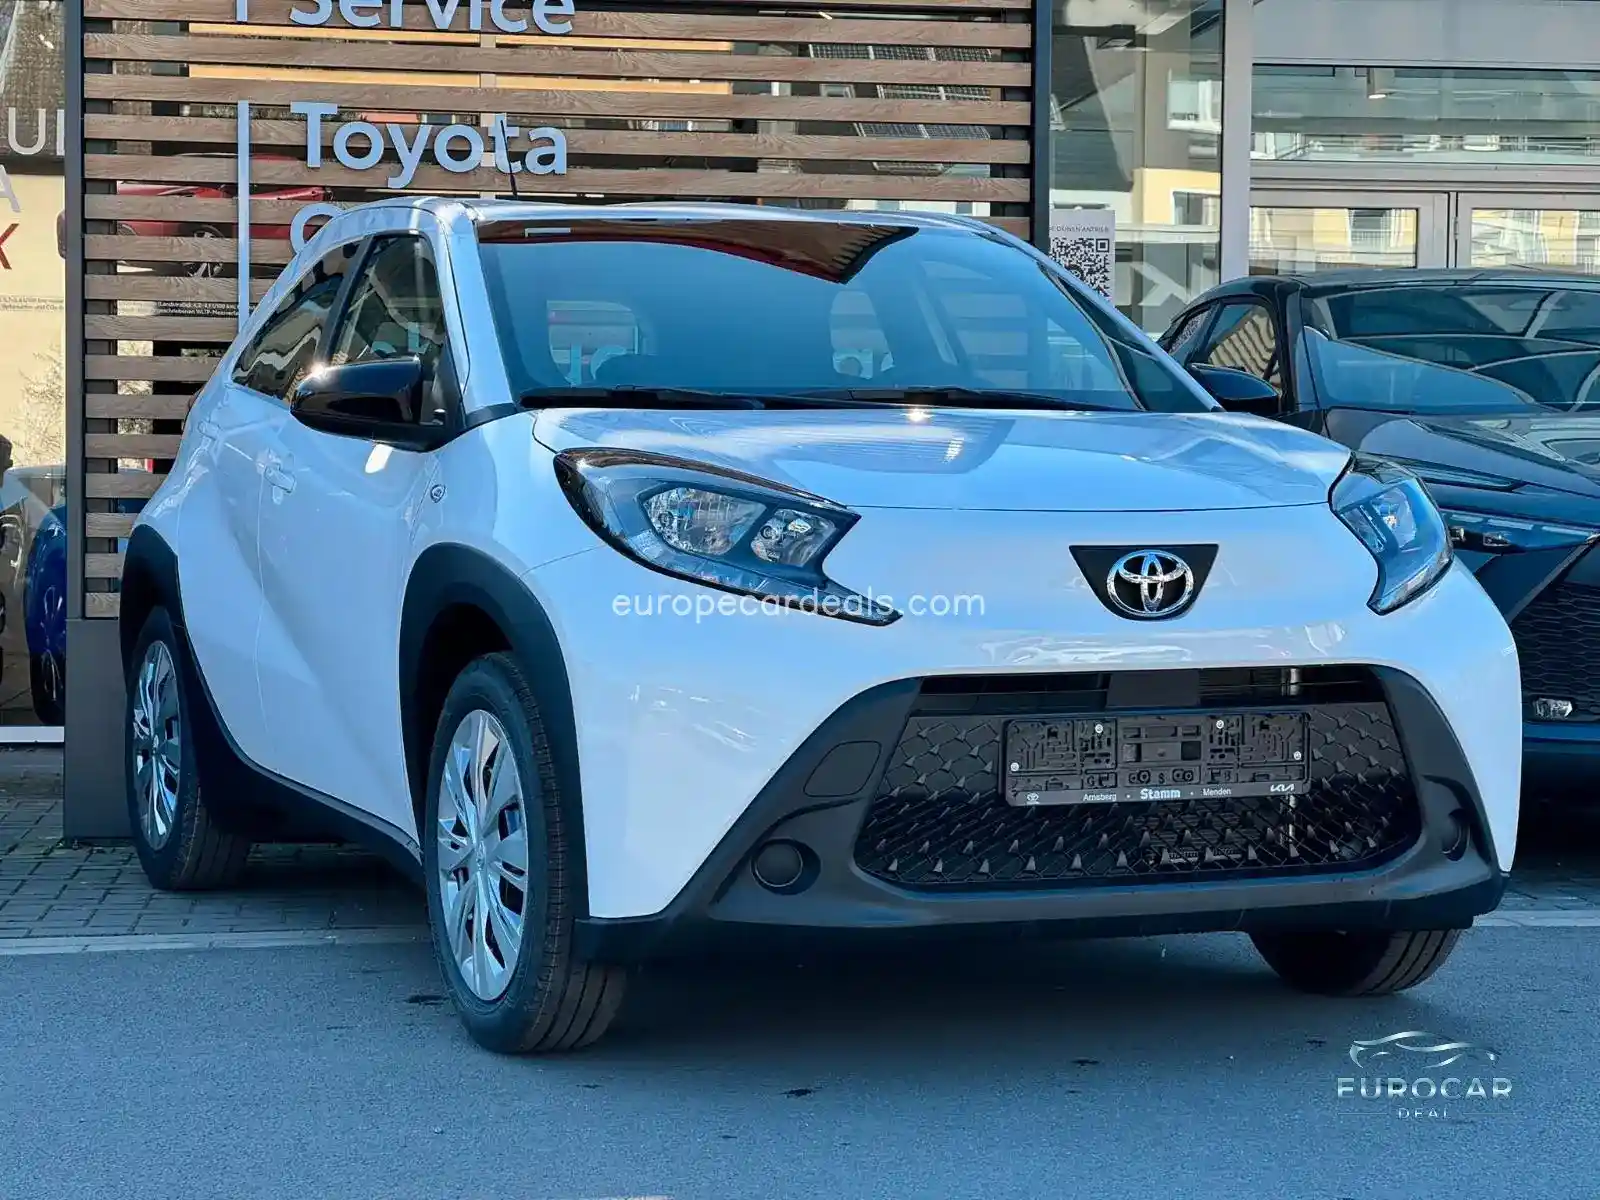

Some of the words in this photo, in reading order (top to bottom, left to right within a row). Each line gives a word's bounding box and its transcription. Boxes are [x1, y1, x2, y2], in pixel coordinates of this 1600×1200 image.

[290, 101, 567, 190] Toyota
[1082, 792, 1117, 802] Arnsberg
[1140, 788, 1181, 800] Stamm
[1202, 788, 1232, 797] Menden
